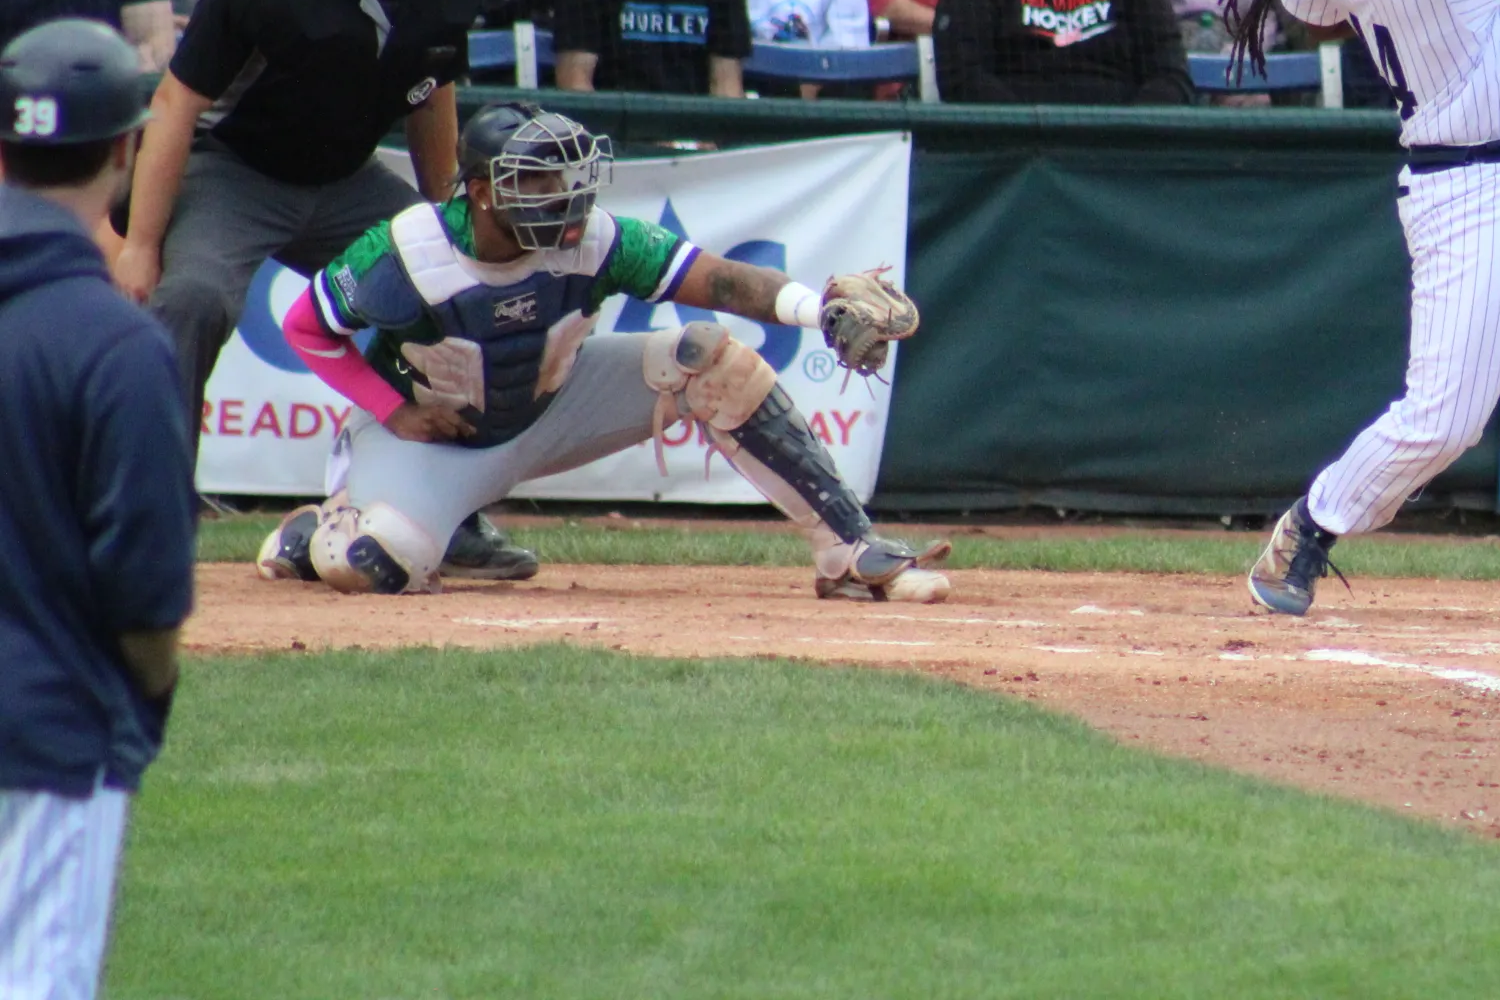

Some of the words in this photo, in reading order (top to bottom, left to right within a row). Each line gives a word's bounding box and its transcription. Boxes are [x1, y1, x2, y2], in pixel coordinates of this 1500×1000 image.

[620, 11, 709, 35] HURLEY
[14, 96, 57, 136] 39
[200, 399, 352, 440] READY
